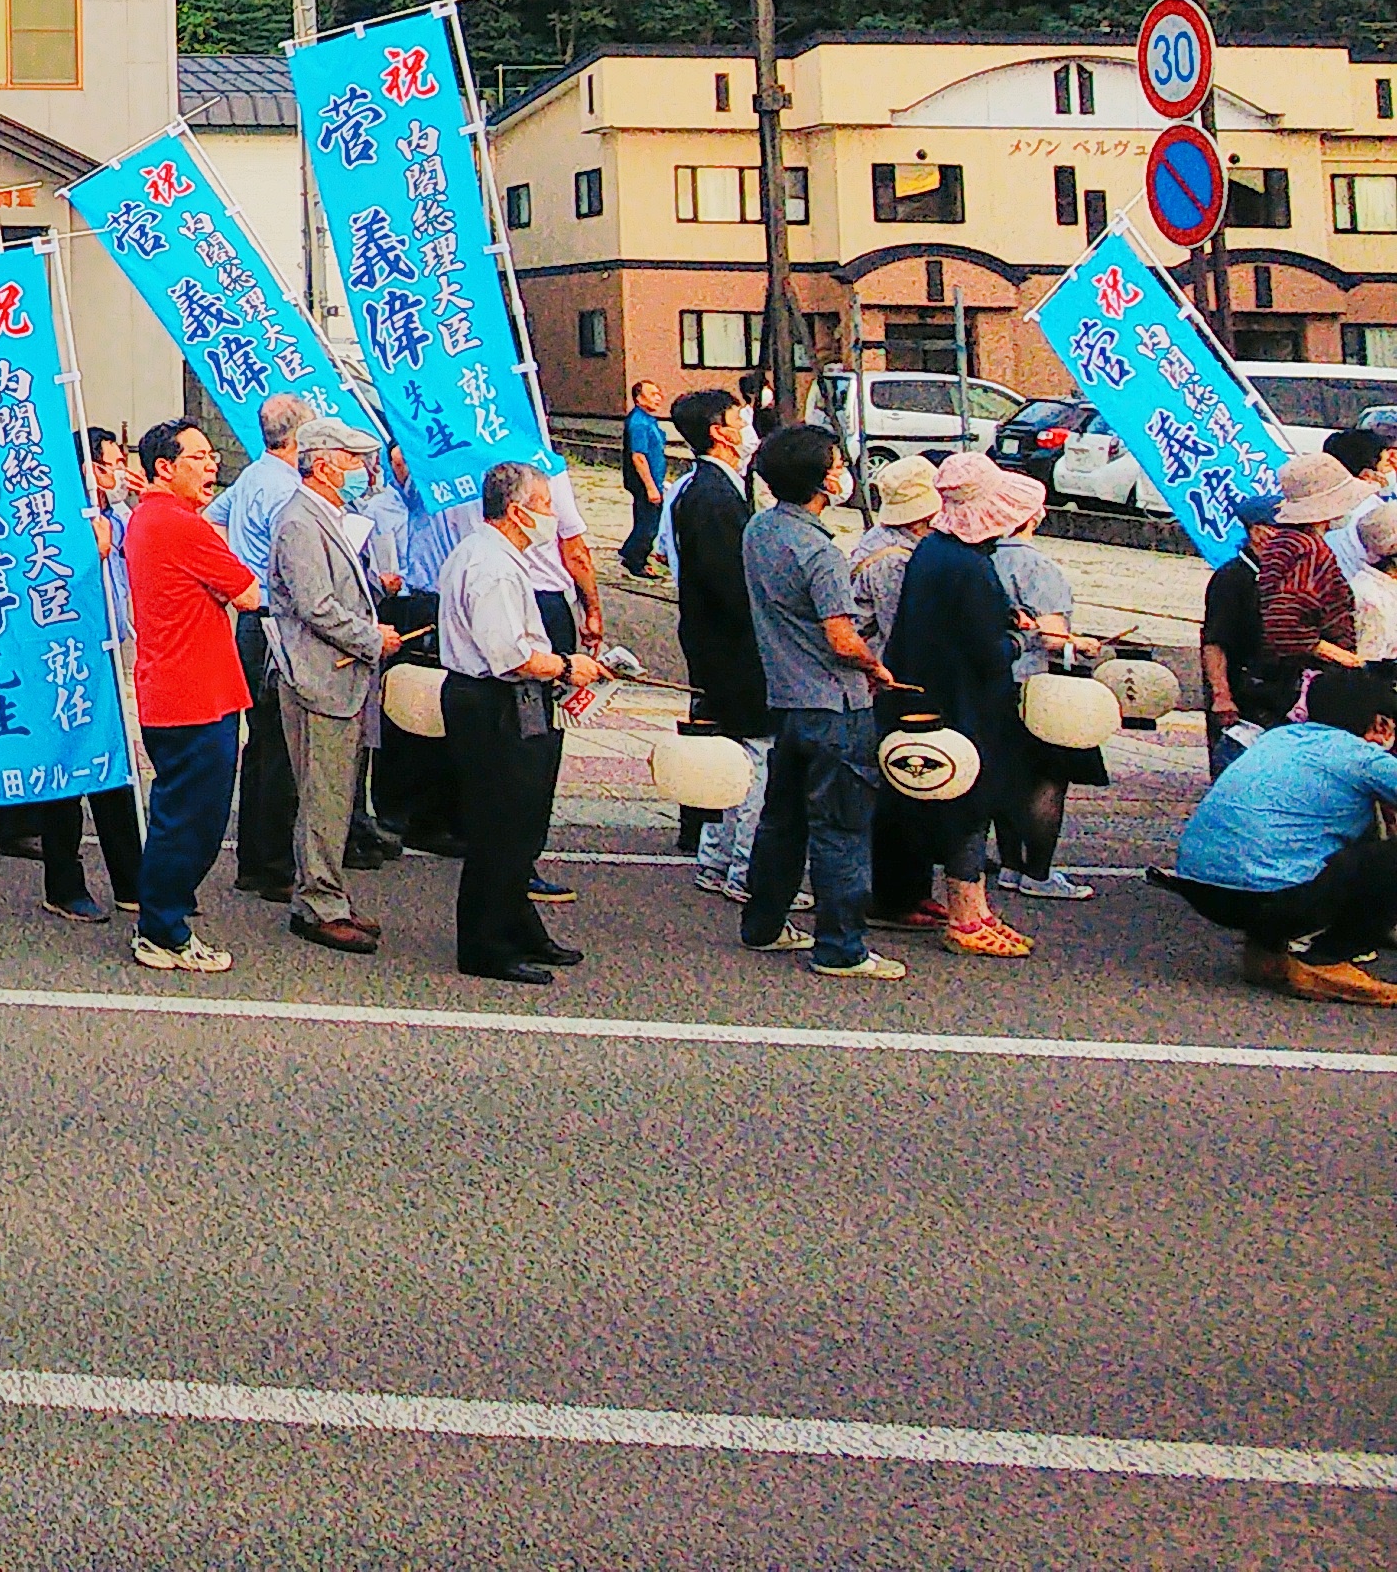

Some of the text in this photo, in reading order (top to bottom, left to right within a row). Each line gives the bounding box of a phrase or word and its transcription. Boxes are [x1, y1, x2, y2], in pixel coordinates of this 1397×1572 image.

[380, 46, 441, 106] 祝
[1152, 31, 1195, 87] 30
[1008, 138, 1061, 156] メゾン
[142, 159, 193, 208] 祝
[1090, 264, 1144, 321] 祝
